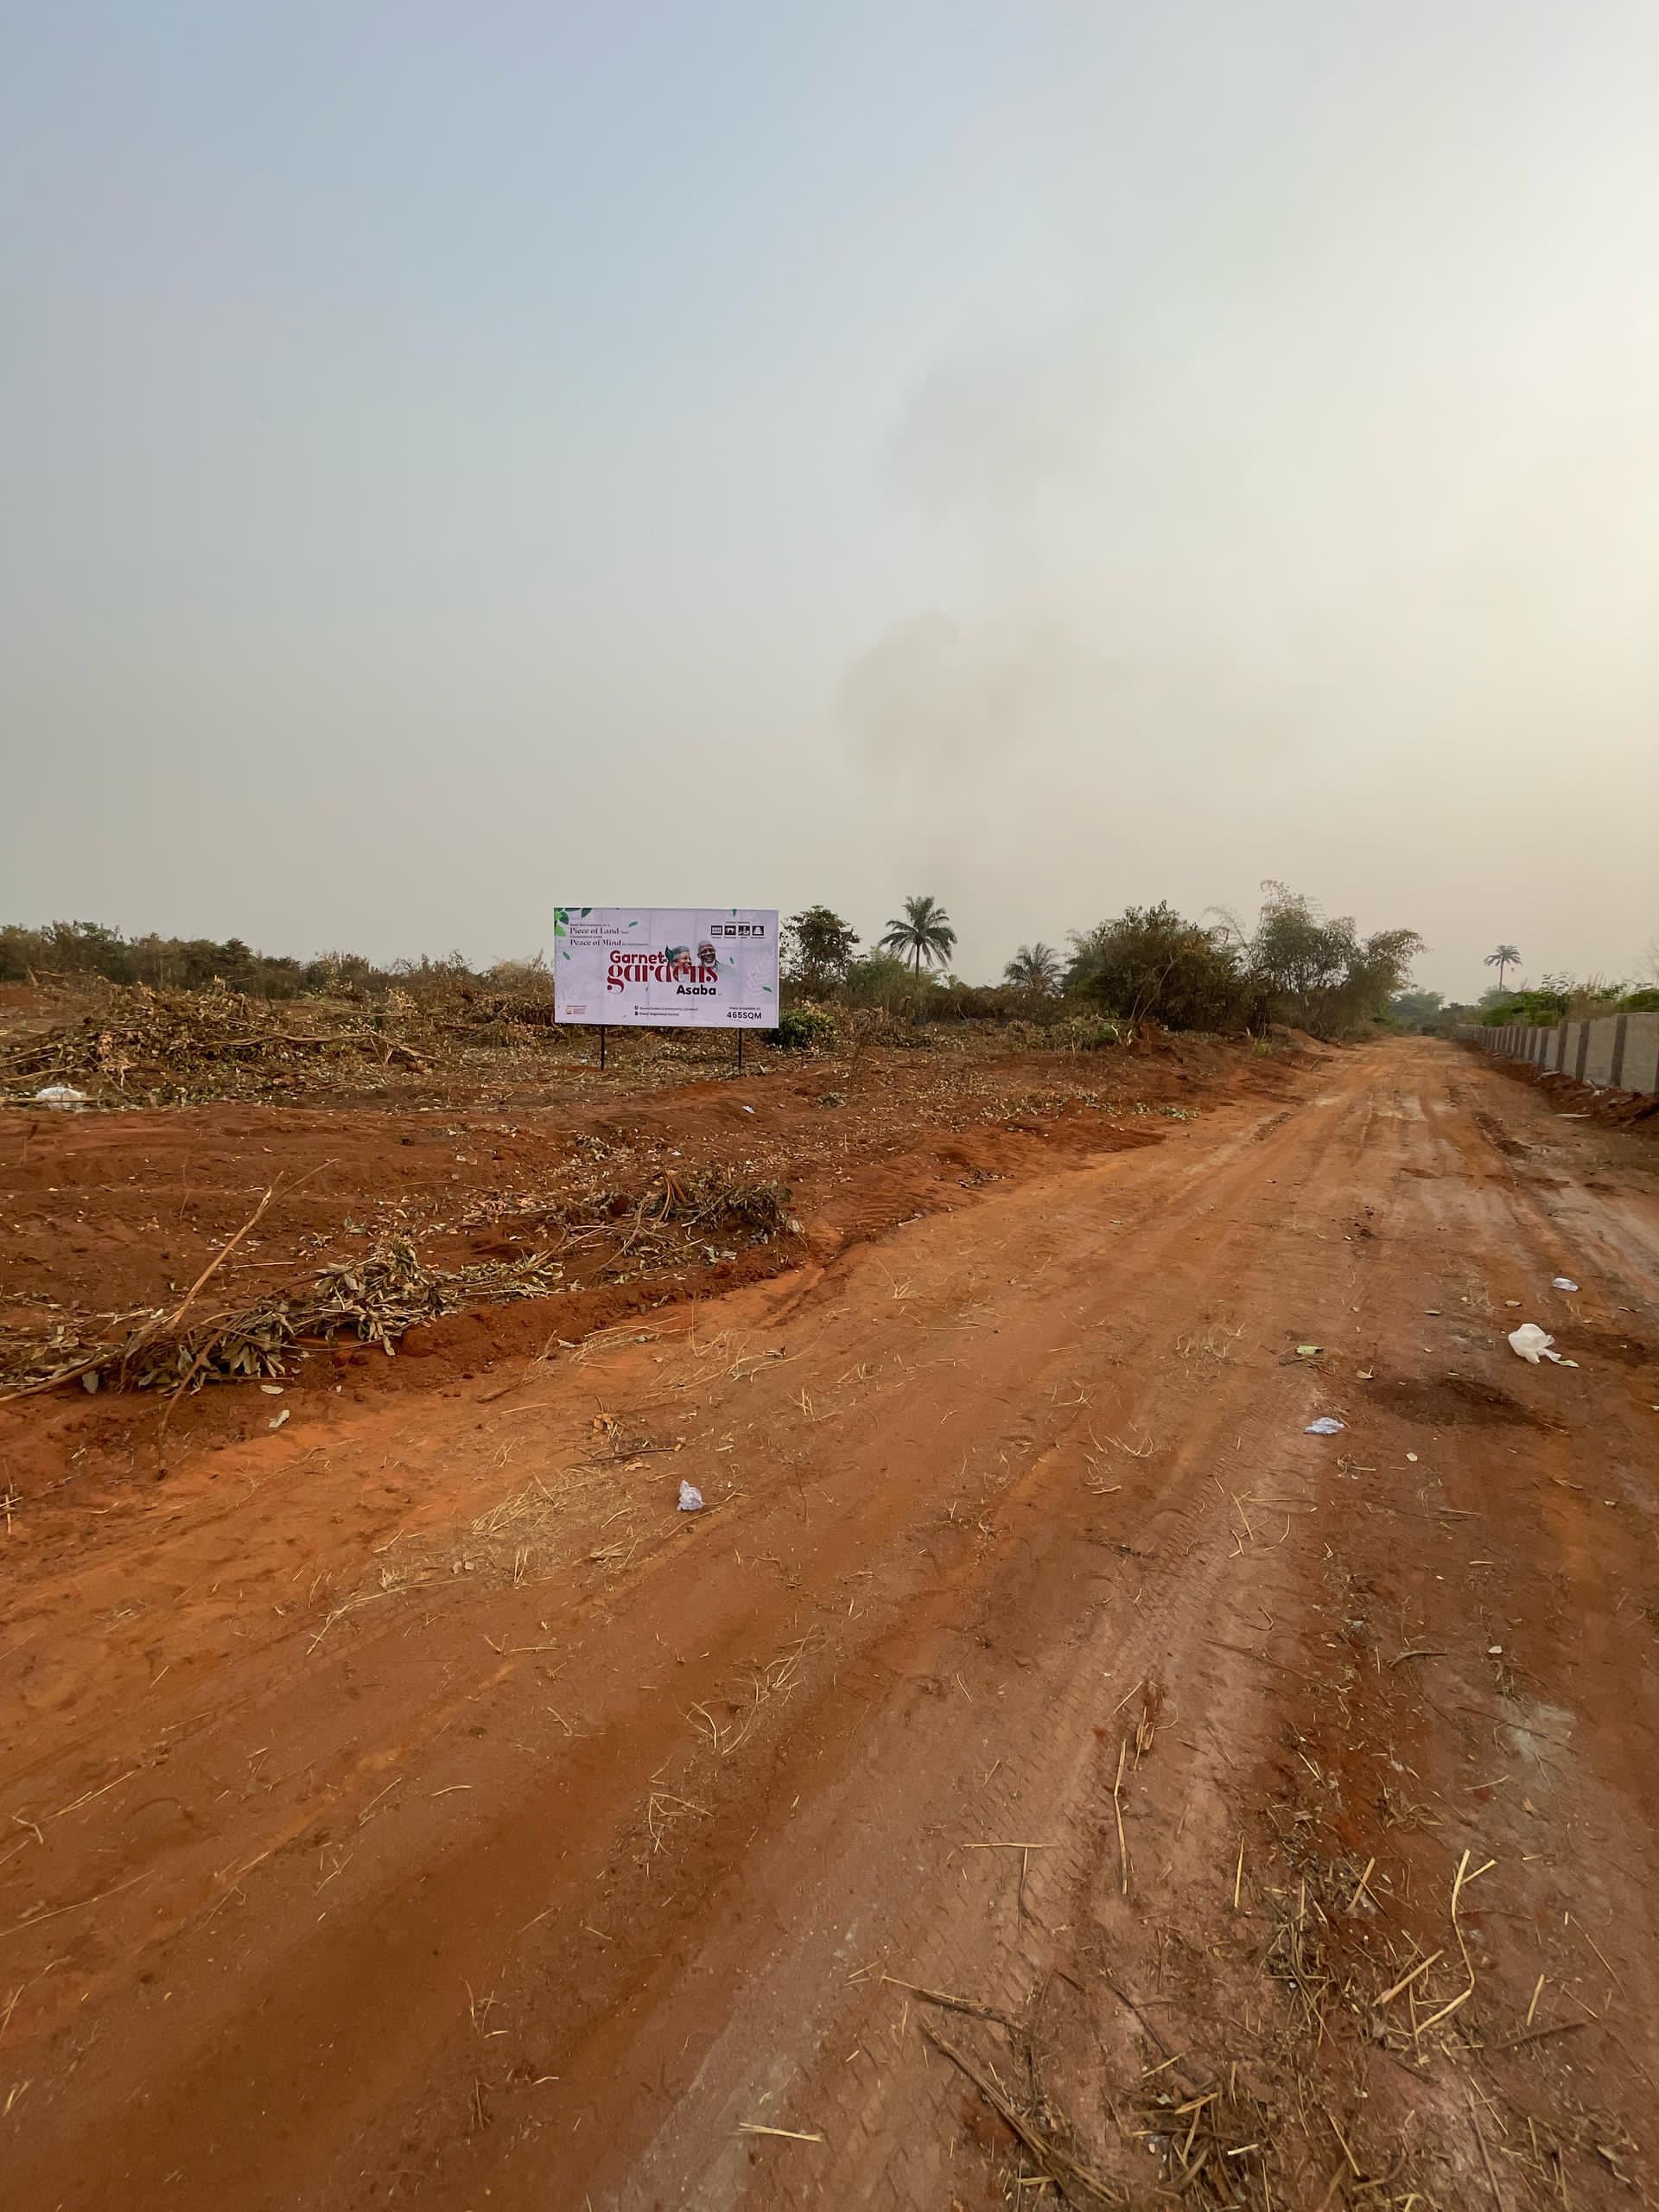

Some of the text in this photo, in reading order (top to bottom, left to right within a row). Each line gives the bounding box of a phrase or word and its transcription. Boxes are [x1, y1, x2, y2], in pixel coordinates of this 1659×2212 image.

[610, 950, 664, 964] Garnet
[607, 963, 718, 995] gardens
[677, 985, 716, 995] Asaba
[727, 1011, 762, 1020] 465SQM
